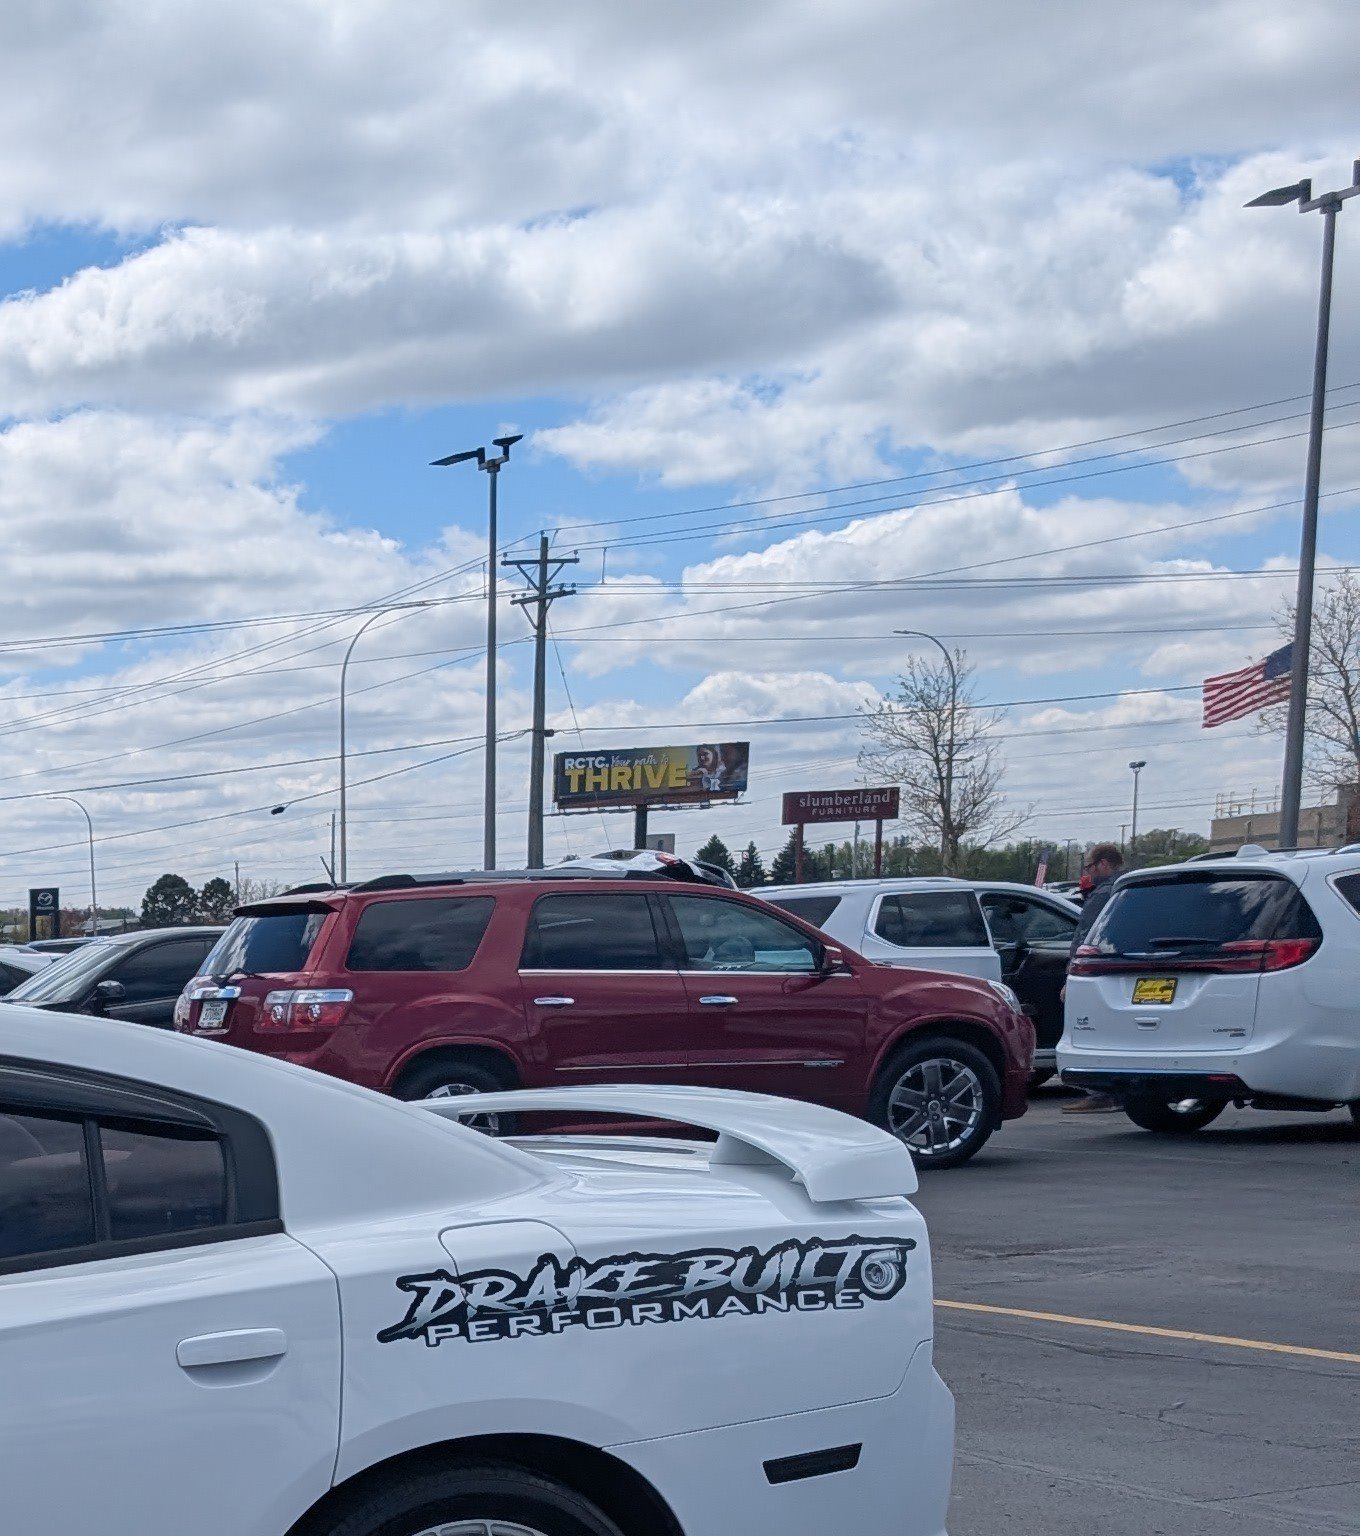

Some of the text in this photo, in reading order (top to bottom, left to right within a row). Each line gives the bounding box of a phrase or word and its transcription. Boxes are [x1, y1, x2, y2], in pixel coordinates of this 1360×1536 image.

[799, 788, 891, 808] slumberland
[811, 804, 877, 816] FURNITURE
[377, 1234, 914, 1342] DRAKE BUILT
[426, 1288, 864, 1347] PERFORMANCE
